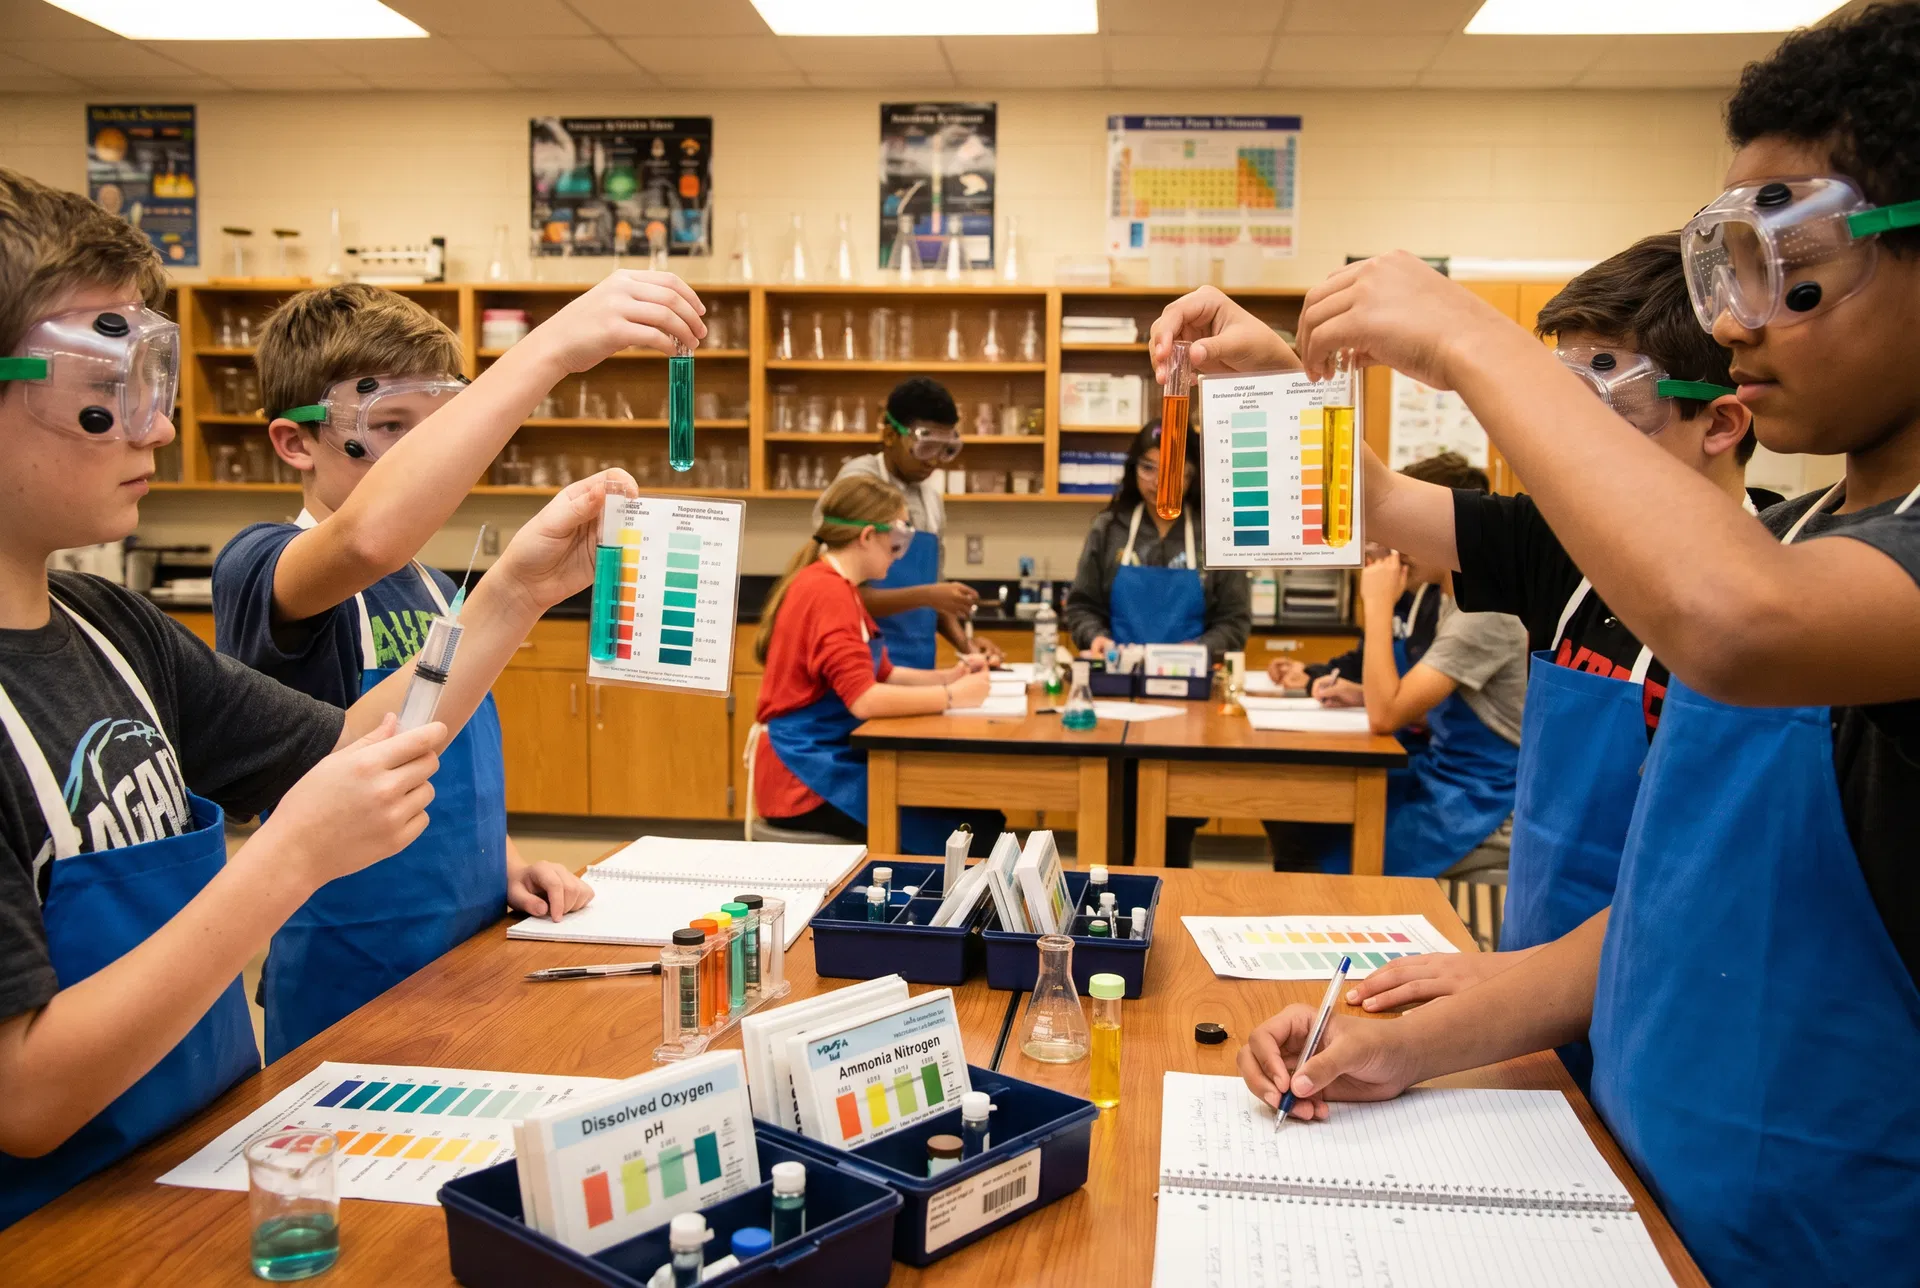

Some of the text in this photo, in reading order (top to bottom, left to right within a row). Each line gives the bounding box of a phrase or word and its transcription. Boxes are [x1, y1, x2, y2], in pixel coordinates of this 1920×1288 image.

[839, 1036, 941, 1081] Ammonia Nitrogen
[581, 1081, 714, 1136] Dissolved Oxygen
[644, 1120, 665, 1144] pH
